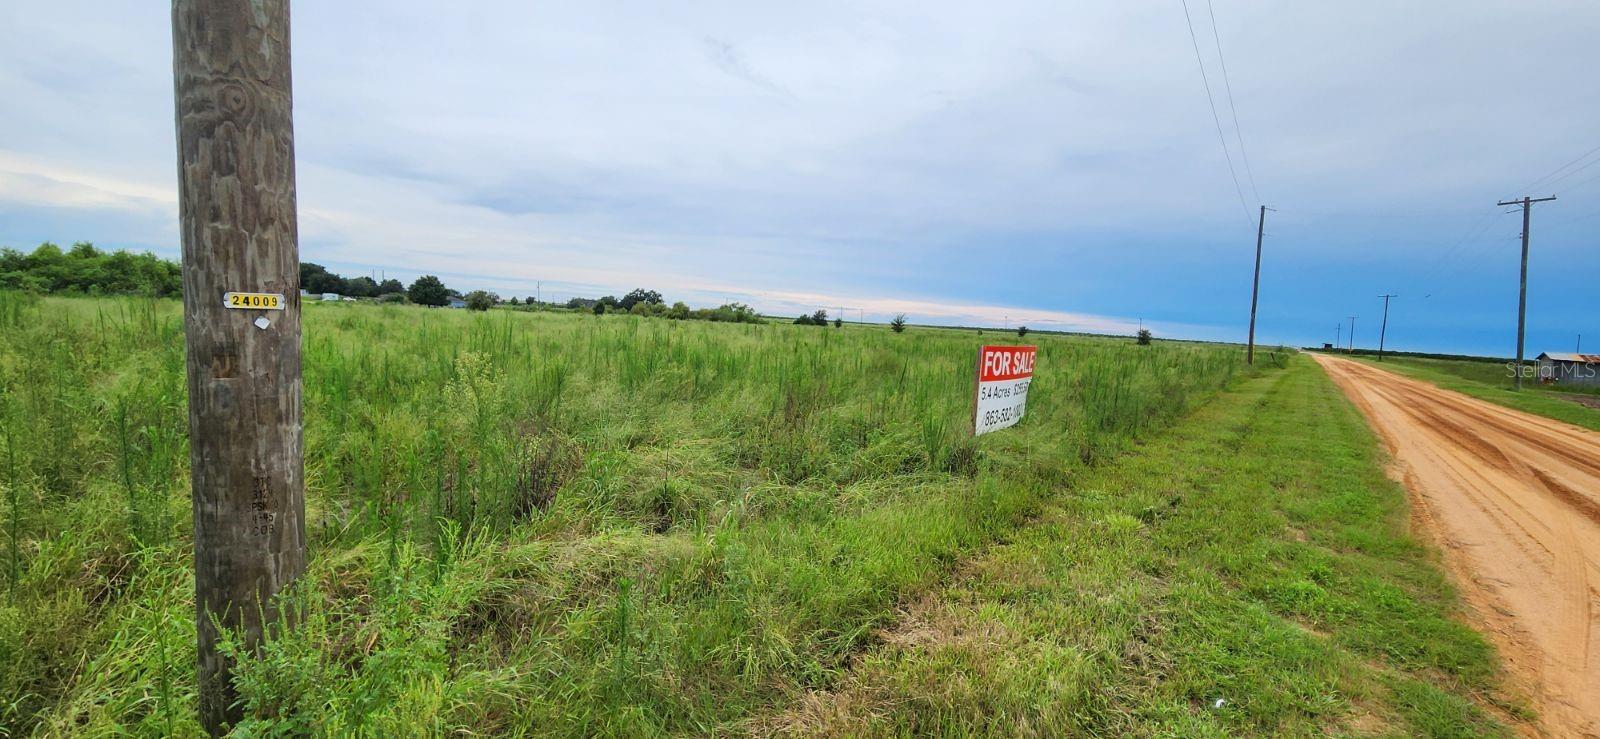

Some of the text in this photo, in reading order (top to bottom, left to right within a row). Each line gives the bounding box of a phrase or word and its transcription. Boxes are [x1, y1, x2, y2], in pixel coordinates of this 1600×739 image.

[232, 295, 278, 307] 24009
[983, 351, 1036, 377] FOR SALE
[993, 385, 1011, 399] Acres
